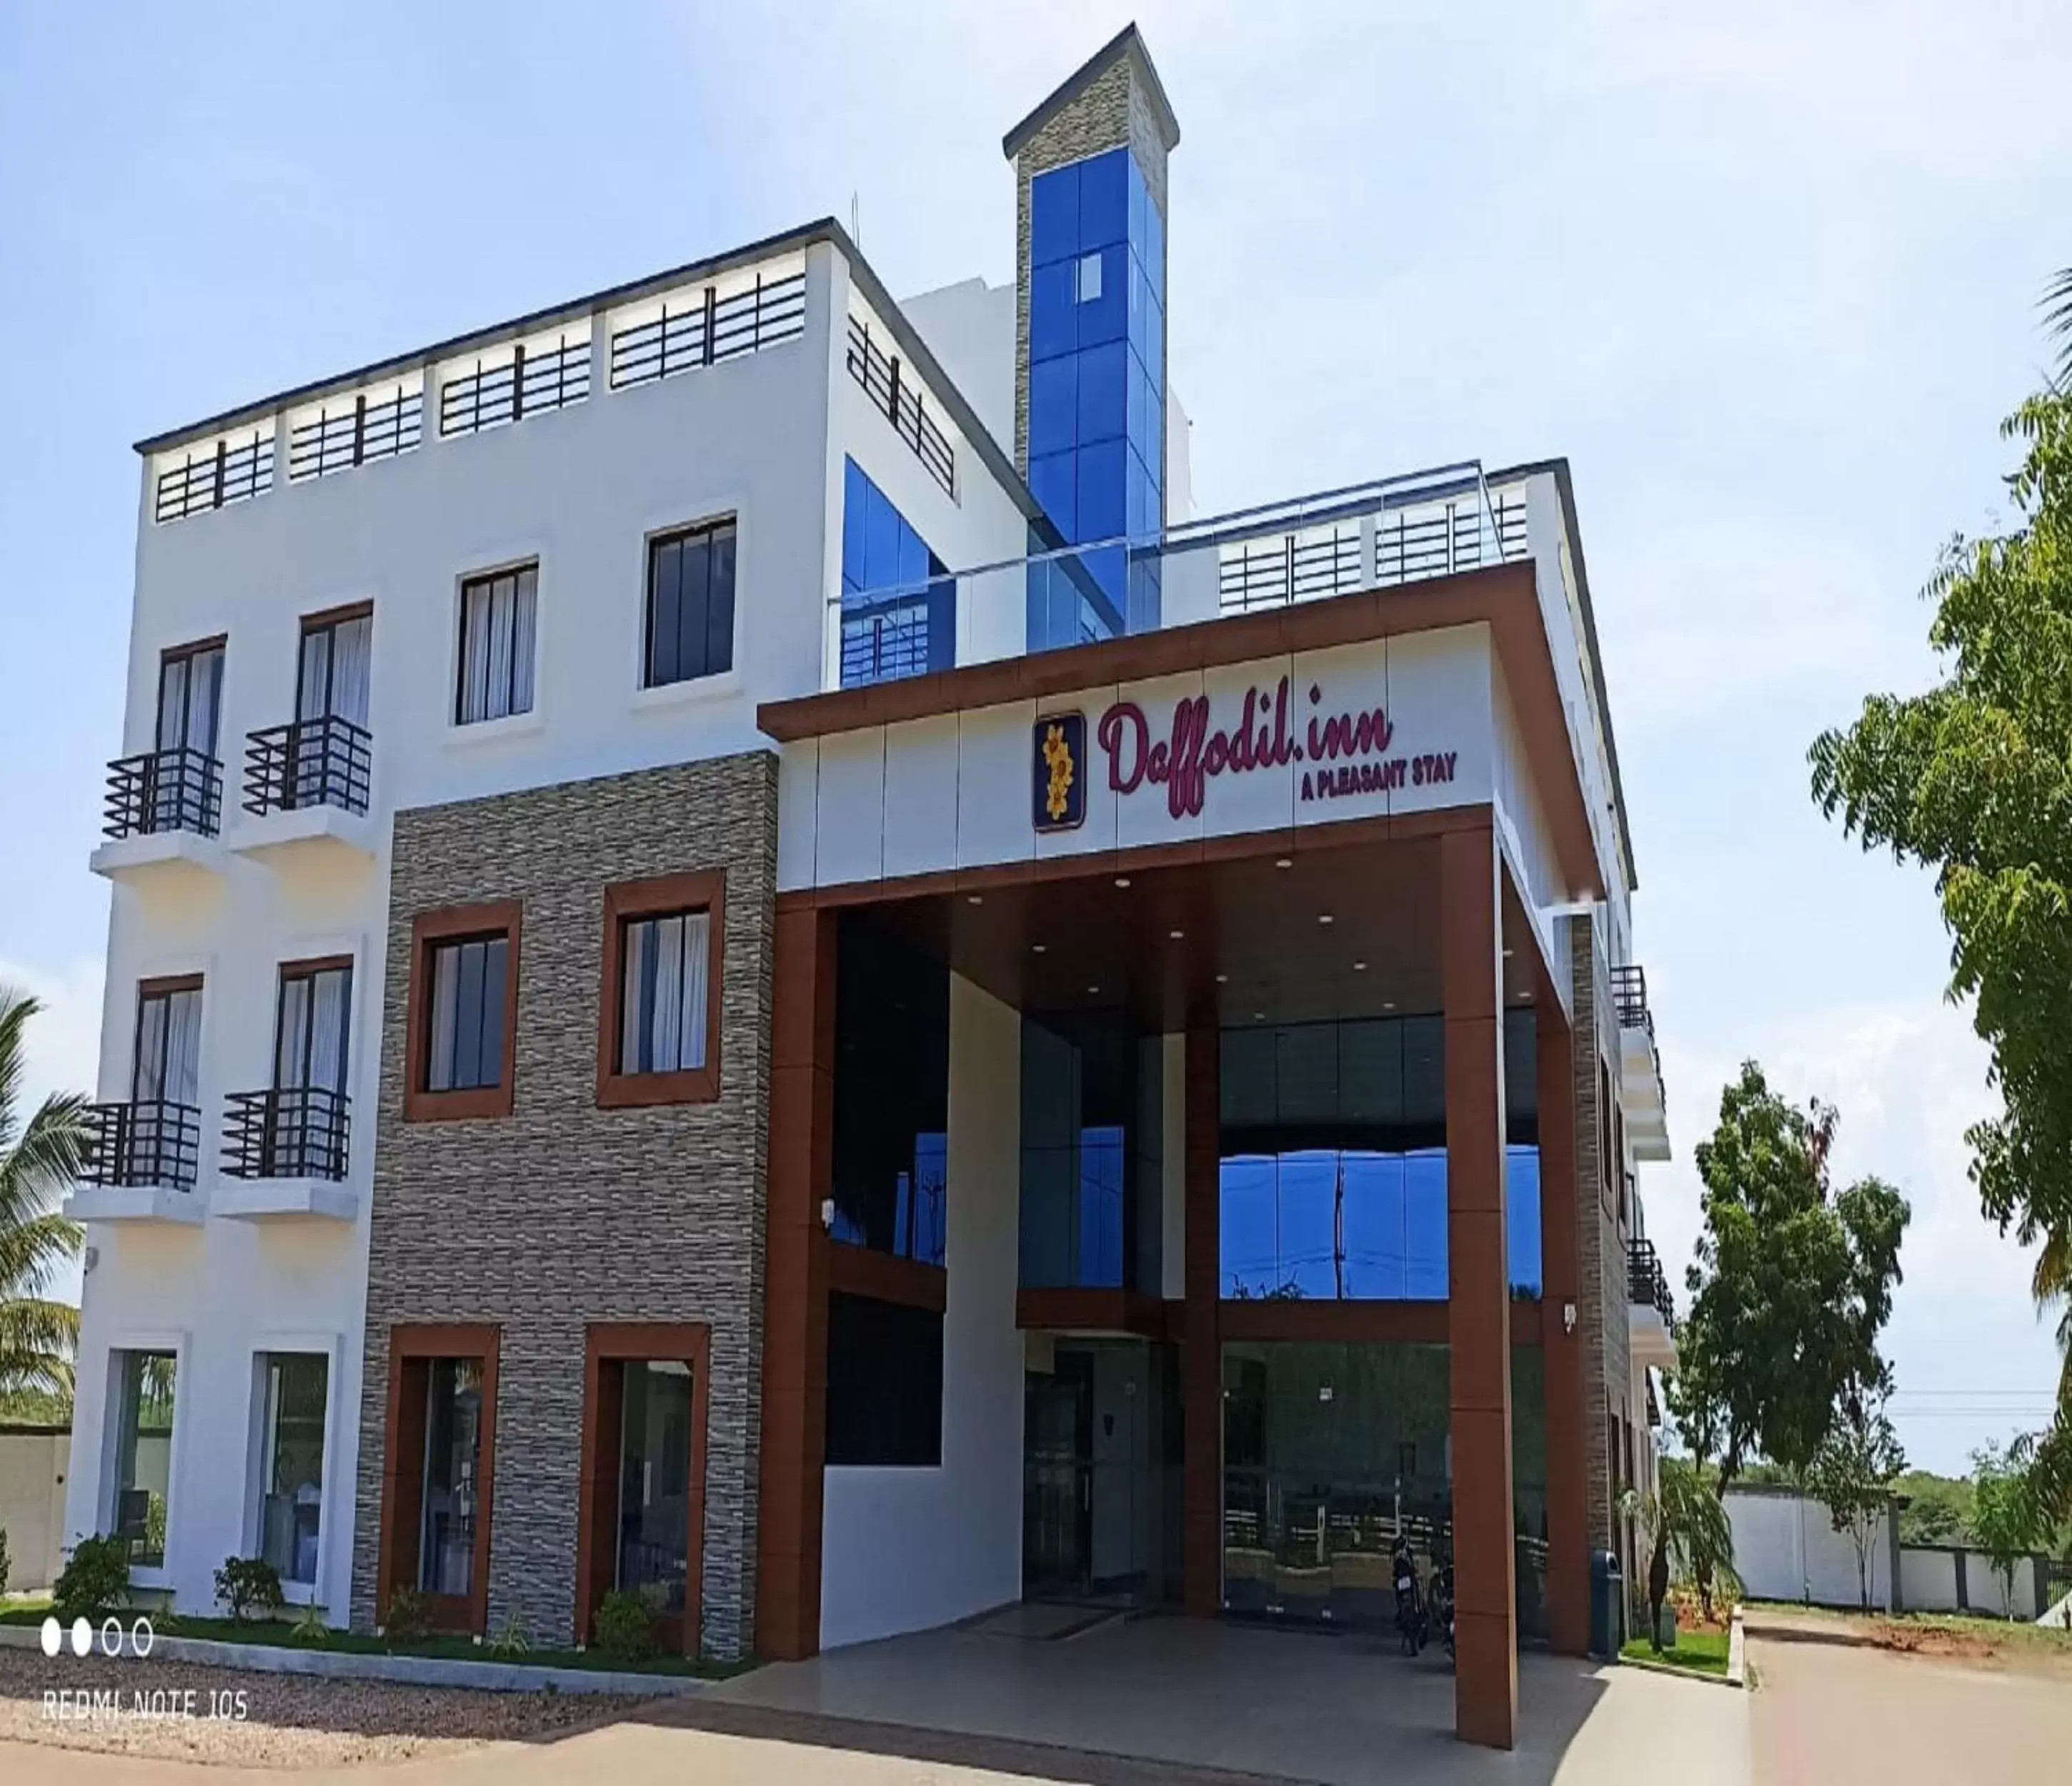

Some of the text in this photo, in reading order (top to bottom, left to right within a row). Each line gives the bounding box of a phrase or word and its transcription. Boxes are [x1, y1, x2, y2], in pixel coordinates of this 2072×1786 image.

[1301, 752, 1458, 801] A PLEASANT STAY
